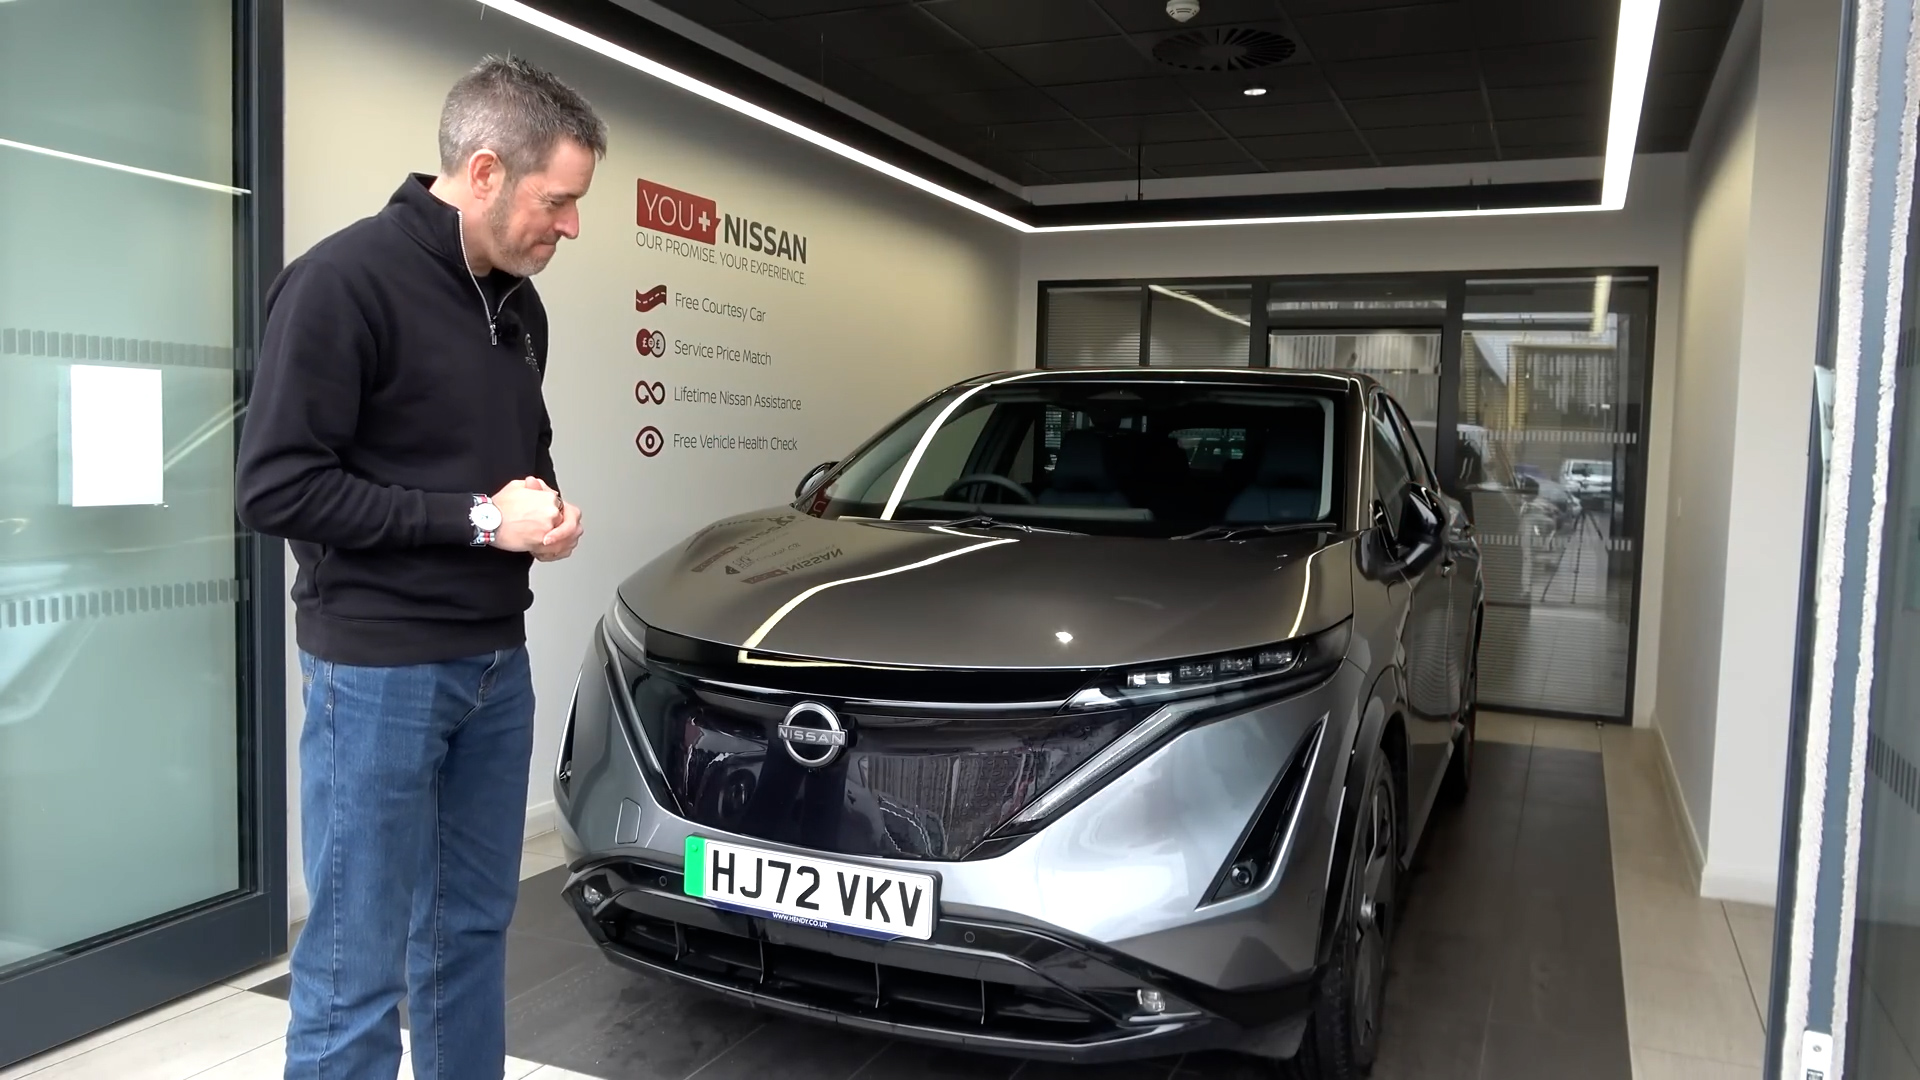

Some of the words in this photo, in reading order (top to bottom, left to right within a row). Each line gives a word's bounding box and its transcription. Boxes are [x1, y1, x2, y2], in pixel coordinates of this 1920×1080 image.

[724, 213, 807, 264] NISSAN
[636, 231, 663, 251] OUR
[666, 239, 718, 264] PROMISE.
[720, 252, 748, 271] YOUR
[750, 260, 807, 285] EXPERIENCE.
[675, 292, 699, 311] Free
[702, 298, 748, 322] Courtesy
[750, 307, 766, 322] Car
[674, 339, 714, 359] Service
[716, 346, 741, 362] Price
[743, 350, 772, 366] Match
[674, 386, 717, 404] Lifetime
[719, 391, 752, 407] Nissan
[754, 394, 802, 411] Assistance
[673, 433, 697, 449] Free
[700, 434, 736, 450] Vehicle
[738, 435, 769, 451] Health
[770, 436, 798, 451] Check
[778, 727, 844, 745] NISSAN
[712, 850, 821, 911] HJ72
[837, 871, 923, 927] VKV
[772, 912, 828, 928] WWW.HENDY.CO.UK
